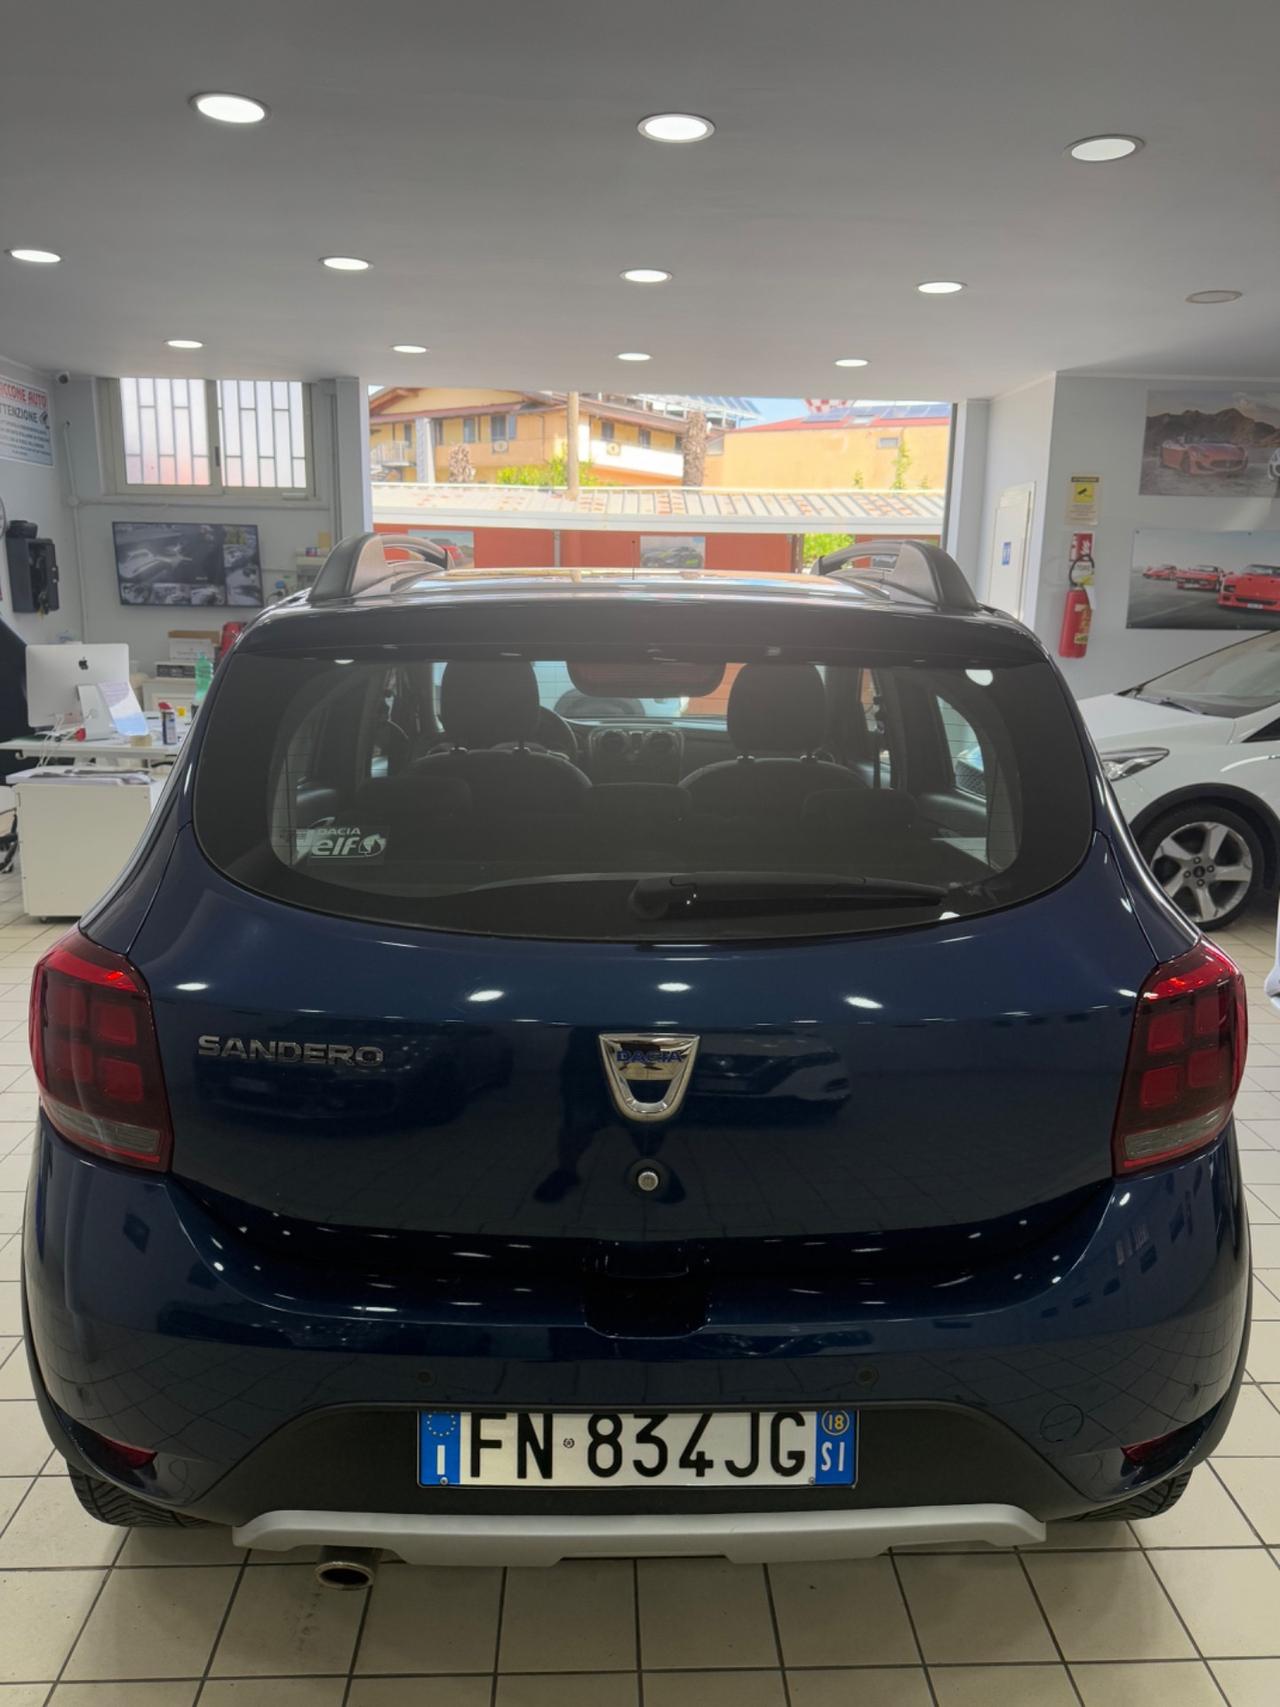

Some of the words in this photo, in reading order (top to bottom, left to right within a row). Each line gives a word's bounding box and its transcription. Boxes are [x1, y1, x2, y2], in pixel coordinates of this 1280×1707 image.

[198, 1035, 384, 1067] SANDERO
[617, 1050, 682, 1063] DACIA
[828, 1414, 845, 1431] 18
[821, 1441, 846, 1472] SI
